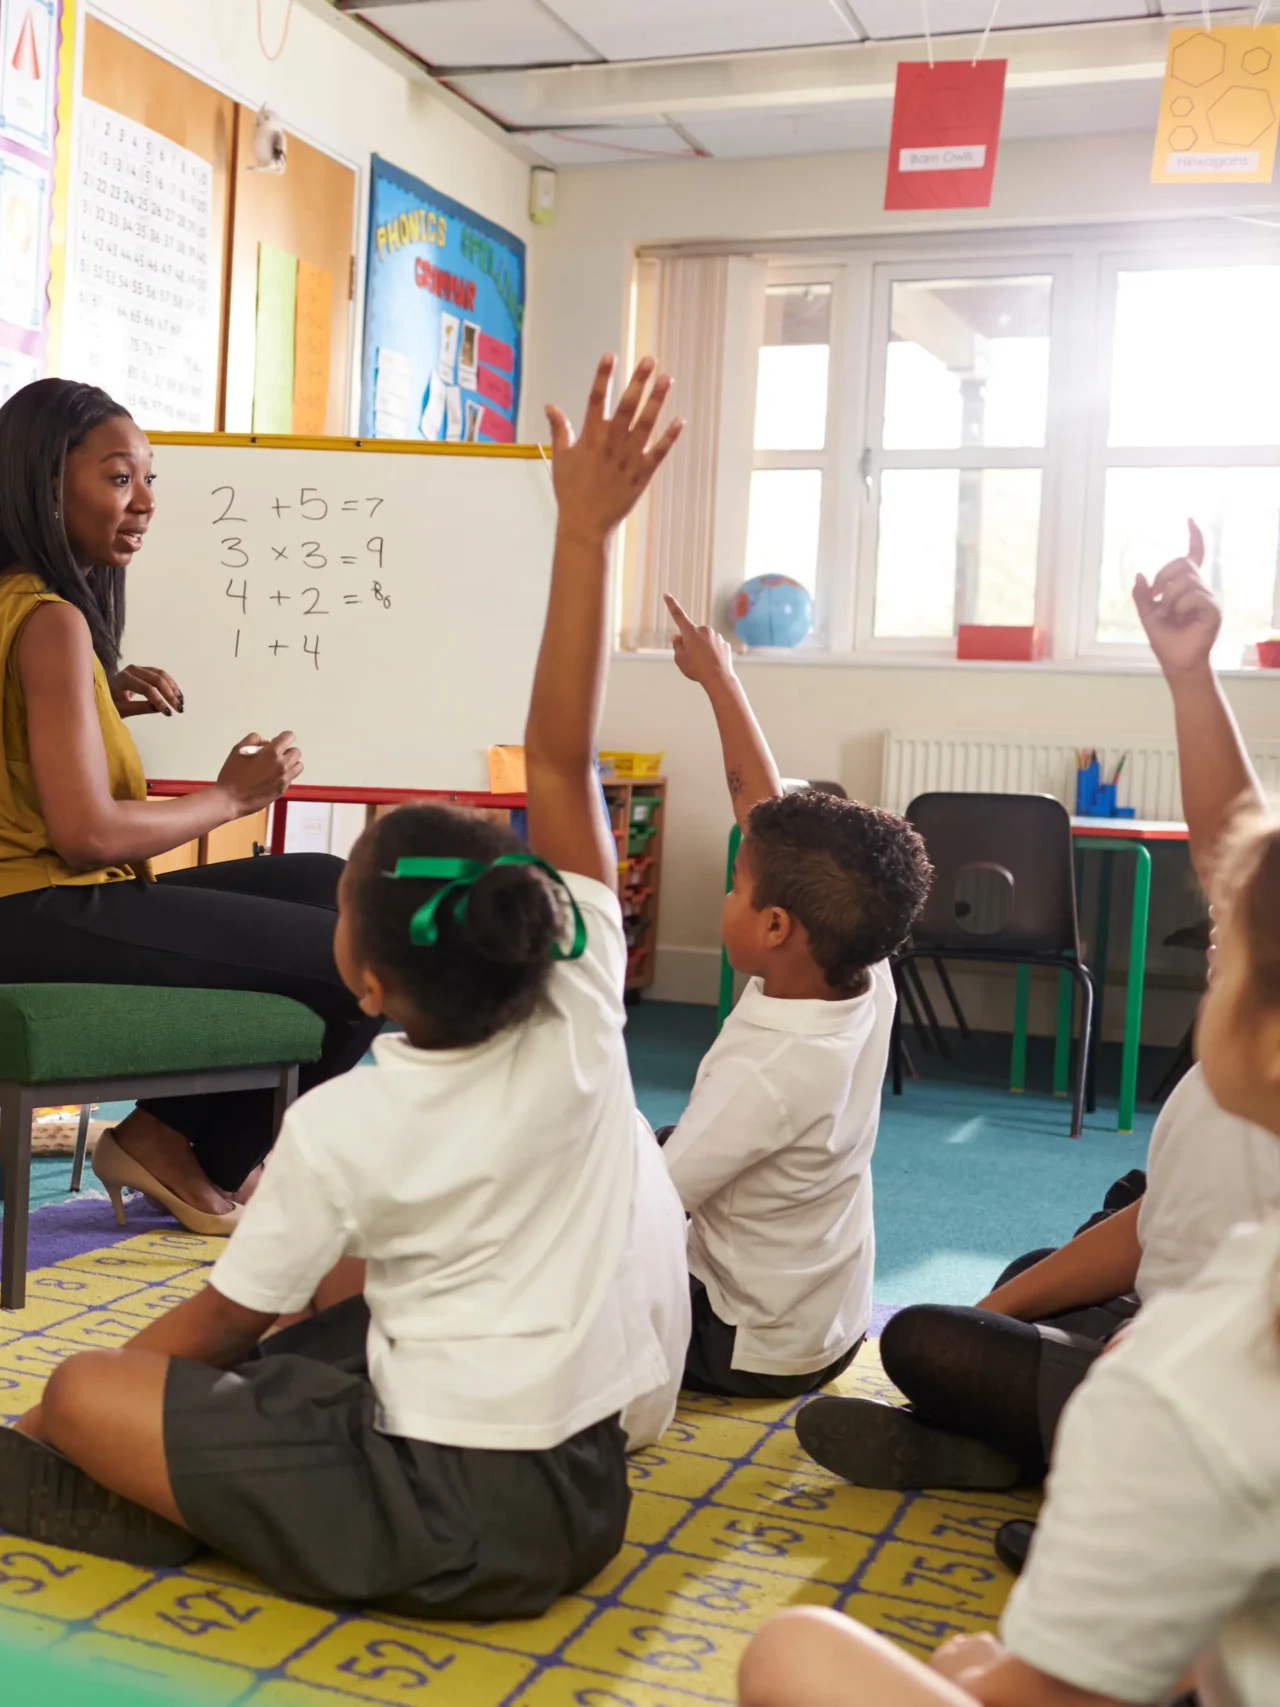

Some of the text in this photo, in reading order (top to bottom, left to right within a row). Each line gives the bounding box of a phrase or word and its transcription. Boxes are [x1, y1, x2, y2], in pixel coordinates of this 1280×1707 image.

[1177, 157, 1249, 170] Hexagons
[376, 209, 448, 263] PHONICS
[147, 1234, 208, 1251] 10
[710, 1519, 805, 1558] 65
[666, 1571, 763, 1612] 64
[901, 1555, 997, 1600] 75
[155, 1591, 264, 1637] 42
[335, 1638, 457, 1689] 52
[616, 1624, 717, 1673] 63
